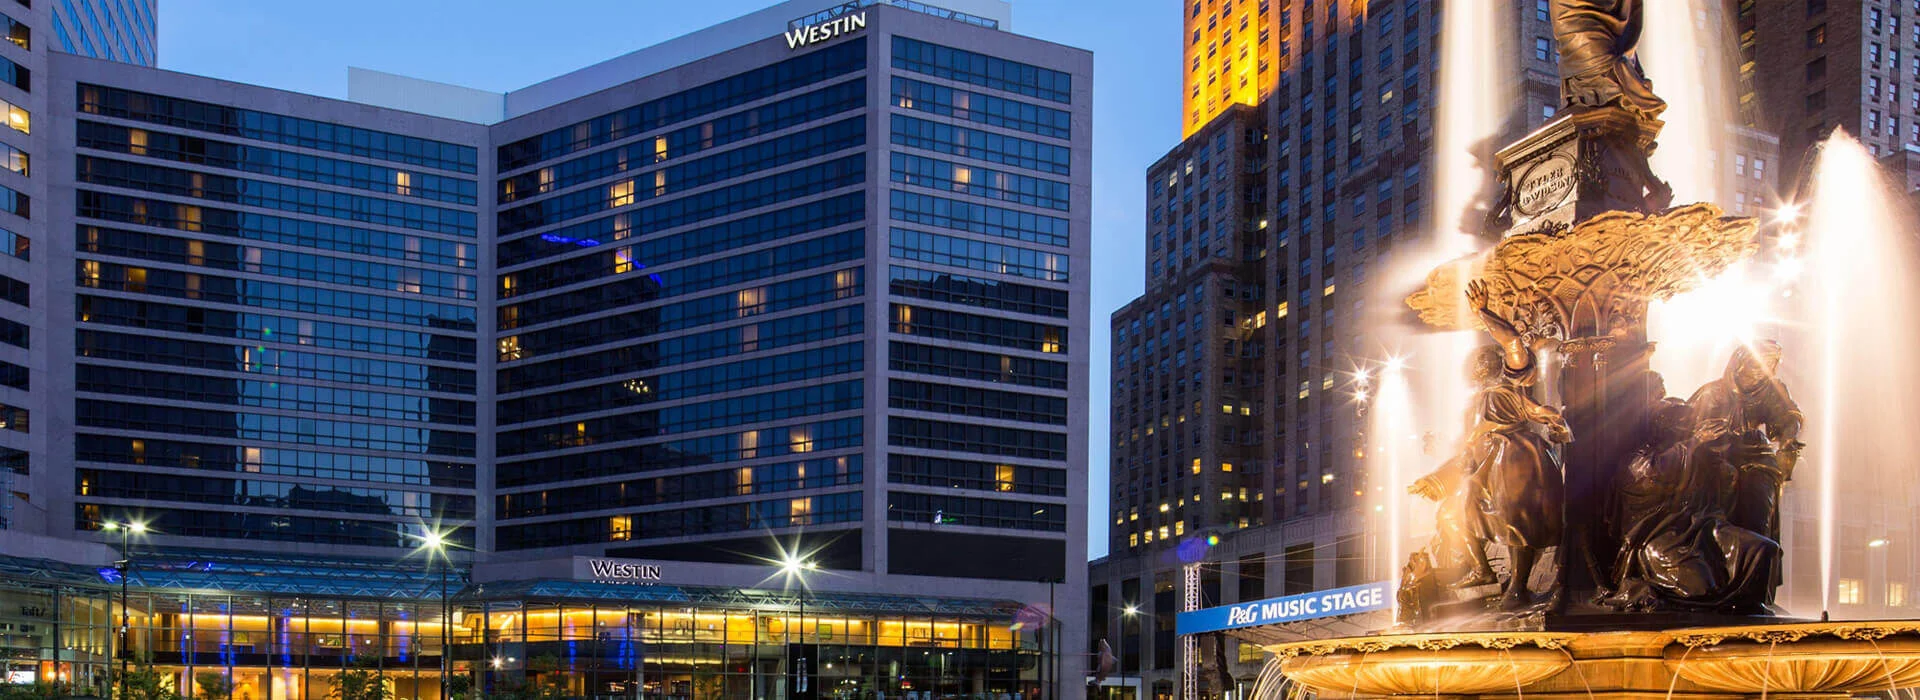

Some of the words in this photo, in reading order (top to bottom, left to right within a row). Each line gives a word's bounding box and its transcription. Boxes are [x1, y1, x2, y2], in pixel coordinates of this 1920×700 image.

[784, 12, 866, 49] WESTIN
[1525, 168, 1563, 191] TYLER
[590, 559, 661, 580] WESTIN
[1226, 603, 1258, 626] P&G
[1261, 596, 1317, 620] MUSIC
[1321, 587, 1382, 612] STAGE
